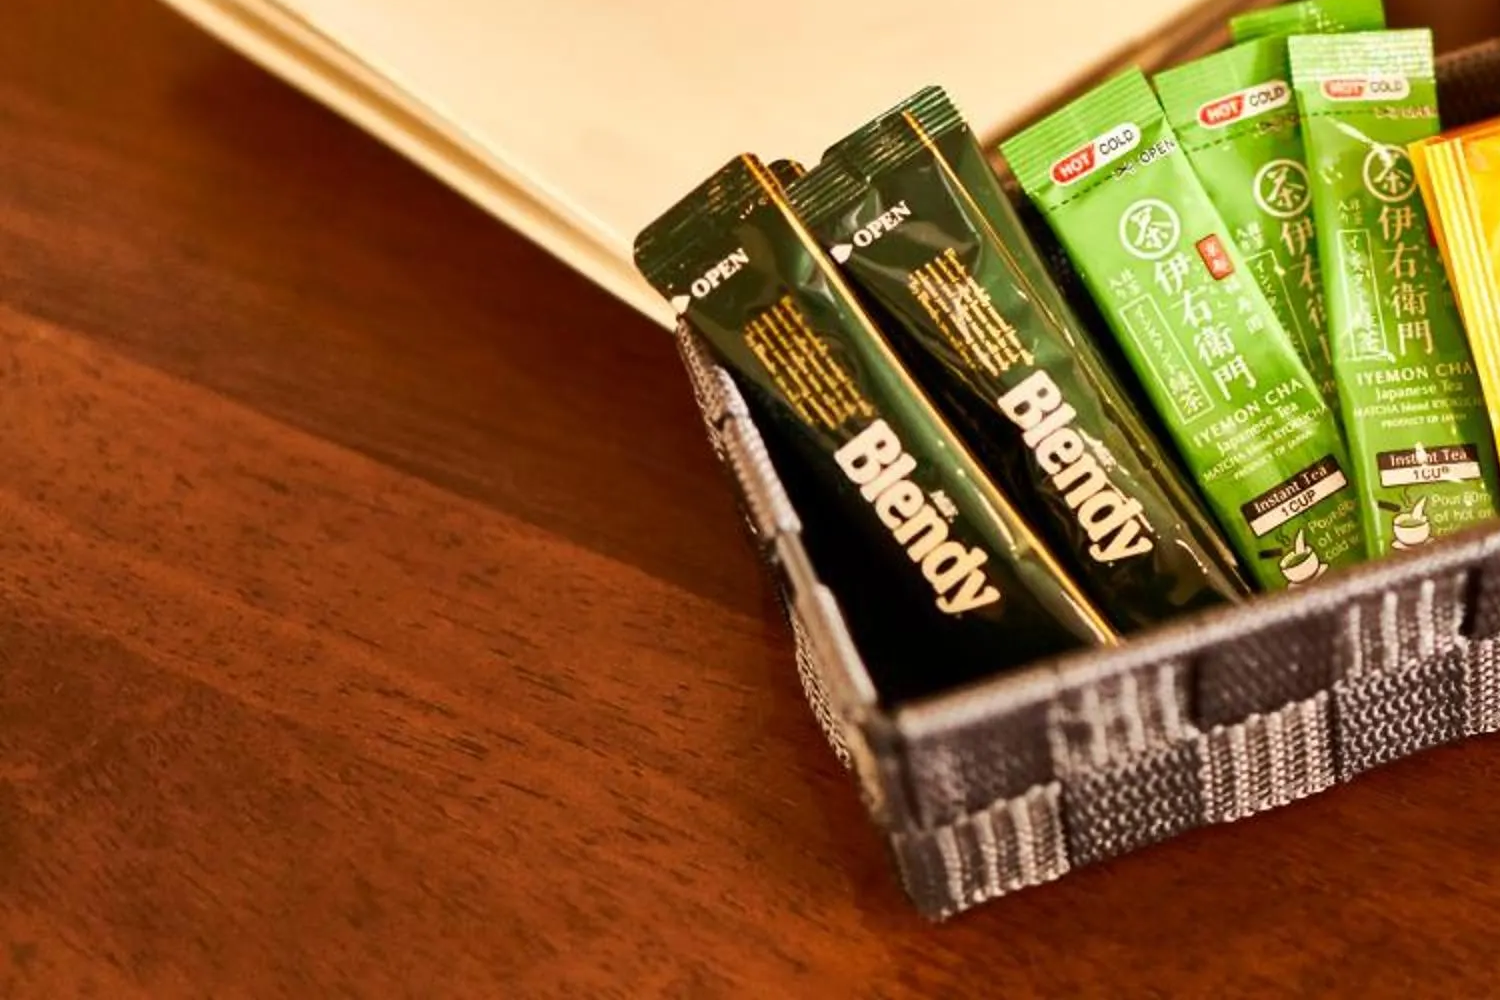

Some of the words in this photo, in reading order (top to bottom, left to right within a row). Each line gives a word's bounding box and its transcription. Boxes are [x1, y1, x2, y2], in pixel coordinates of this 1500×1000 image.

[1248, 84, 1287, 108] COLD
[1057, 152, 1091, 181] HOT
[1099, 129, 1135, 157] COLD
[1138, 138, 1176, 166] OPEN
[854, 201, 912, 248] OPEN
[691, 248, 749, 299] OPEN
[1377, 205, 1435, 358] 伊右衛門
[1154, 252, 1258, 401] 伊右衛門
[1355, 366, 1428, 385] IYEMON
[1435, 360, 1472, 377] CHA
[1375, 383, 1437, 400] Japanese
[1191, 399, 1262, 448] IYEMON
[1262, 374, 1304, 407] CHA
[1216, 413, 1276, 455] Japanese
[1275, 398, 1299, 419] Tea
[998, 370, 1154, 564] Blendy
[1390, 450, 1438, 467] Instnt
[1443, 446, 1467, 461] Tea
[1252, 480, 1302, 514] Instant
[1301, 463, 1328, 484] Tea
[834, 419, 1001, 615] Blendy
